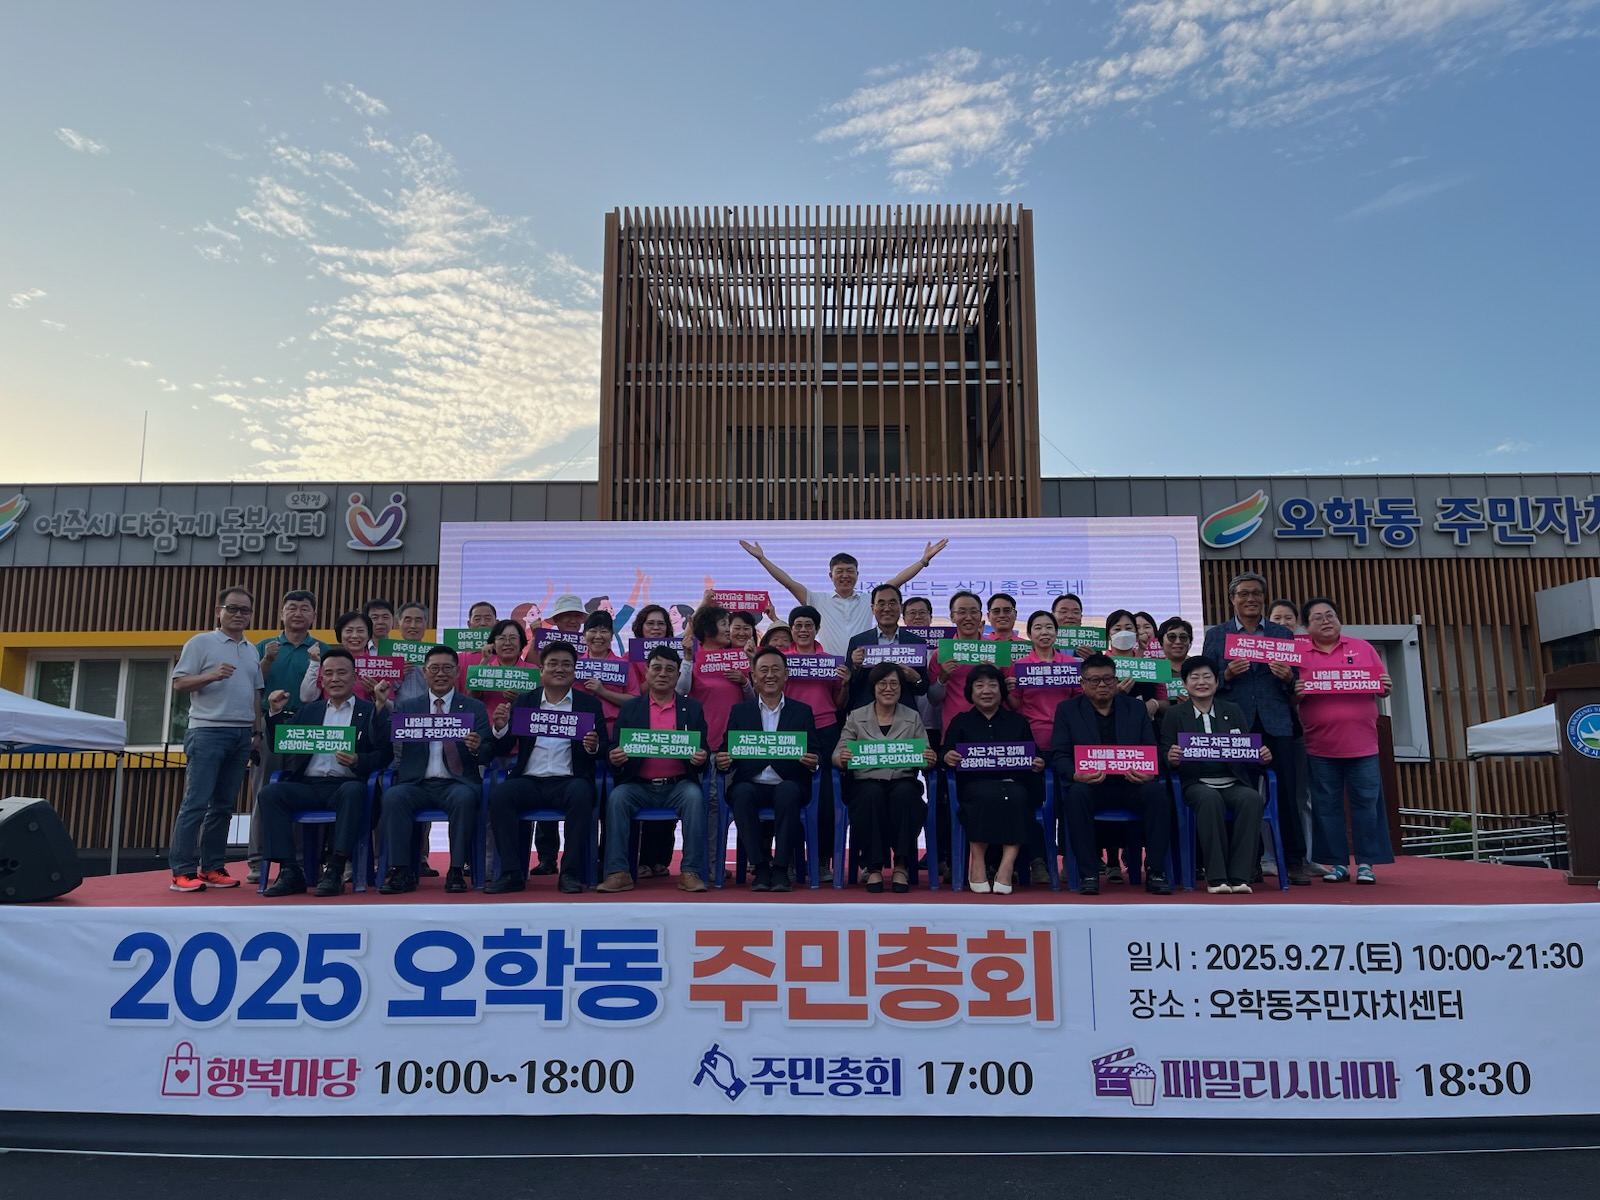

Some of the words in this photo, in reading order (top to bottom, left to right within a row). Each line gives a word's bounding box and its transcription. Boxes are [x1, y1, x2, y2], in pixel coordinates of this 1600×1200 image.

[290, 493, 322, 507] 오학점
[1275, 497, 1421, 547] 오학동
[35, 508, 115, 539] 여주시
[121, 508, 214, 552] 다함께
[219, 506, 324, 556] 돌봄센터
[1001, 580, 1038, 596] 좋은
[1046, 580, 1084, 596] 동네
[1078, 629, 1100, 639] 꿈꾸는
[867, 647, 891, 656] 내일을
[892, 647, 916, 655] 꿈꾸는
[953, 642, 978, 652] 여주의
[1237, 638, 1255, 648] 차근
[1257, 639, 1275, 650] 차근
[1276, 641, 1295, 653] 함께
[1229, 647, 1264, 660] 성장하는
[1266, 650, 1302, 664] 주민자치
[585, 661, 602, 670] 차근
[603, 662, 620, 672] 함께
[801, 658, 818, 668] 차근
[819, 658, 836, 668] 함께
[1139, 661, 1157, 670] 심장
[478, 668, 503, 678] 내일을
[504, 669, 530, 680] 꿈꾸는
[1026, 666, 1051, 675] 내일을
[1053, 665, 1078, 675] 꿈꾸는
[1312, 670, 1340, 680] 내일을
[1341, 670, 1371, 680] 꿈꾸는
[469, 679, 493, 688] 오학동
[495, 679, 537, 690] 주민자치회
[1019, 677, 1044, 686] 오학동
[1304, 680, 1332, 690] 오학동
[1333, 680, 1381, 690] 주민자치회
[405, 717, 433, 727] 내일을
[434, 717, 462, 727] 꿈꾸는
[530, 712, 558, 724] 여주의
[560, 714, 579, 726] 심장
[286, 729, 305, 739] 차근
[306, 729, 325, 739] 차근
[326, 729, 345, 740] 함께
[395, 728, 423, 739] 오학동
[529, 723, 548, 734] 행복
[549, 724, 577, 737] 오학동
[631, 732, 650, 742] 차근
[651, 733, 669, 743] 차근
[670, 734, 690, 745] 함께
[739, 734, 757, 745] 차근
[758, 734, 776, 745] 차근
[778, 735, 796, 745] 함께
[1190, 736, 1210, 747] 차근
[1210, 736, 1230, 747] 차근
[1231, 736, 1251, 748] 함께
[278, 740, 314, 751] 성장하는
[315, 741, 351, 752] 주민자치
[623, 745, 659, 755] 성장하는
[660, 745, 696, 756] 주민자치
[731, 746, 767, 756] 성장하는
[767, 746, 803, 757] 주민자치
[859, 743, 886, 754] 내일을
[887, 742, 914, 753] 꿈꾸는
[967, 746, 986, 757] 차근
[987, 746, 1005, 756] 차근
[1006, 745, 1025, 756] 함께
[851, 754, 878, 765] 오학동
[879, 753, 924, 764] 주민자치회
[1087, 748, 1115, 760] 내일을
[1116, 749, 1145, 760] 꿈꾸는
[1183, 747, 1220, 758] 성장하는
[1221, 748, 1259, 759] 주민자치
[960, 757, 996, 768] 성장하는
[996, 756, 1032, 768] 주민자치
[1079, 760, 1107, 771] 오학동
[1108, 760, 1155, 771] 주민자치회
[1127, 941, 1180, 971] 일시
[1205, 941, 1402, 975] 2025.9.27.(토)
[1412, 942, 1584, 971] 10:00~21:30
[110, 931, 362, 1022] 2025
[387, 928, 663, 1021] 오학동
[689, 926, 1055, 1023] 주민총회
[1129, 989, 1185, 1019] 장소
[1209, 988, 1464, 1021] 오학동주민자치센터
[206, 1057, 362, 1098] 행복마당
[374, 1059, 635, 1095] 10:00~18:00
[749, 1056, 902, 1097] 주민총회
[917, 1060, 1034, 1096] 17:00
[1160, 1059, 1401, 1100] 패밀리시네마
[1414, 1061, 1532, 1098] 18:30
